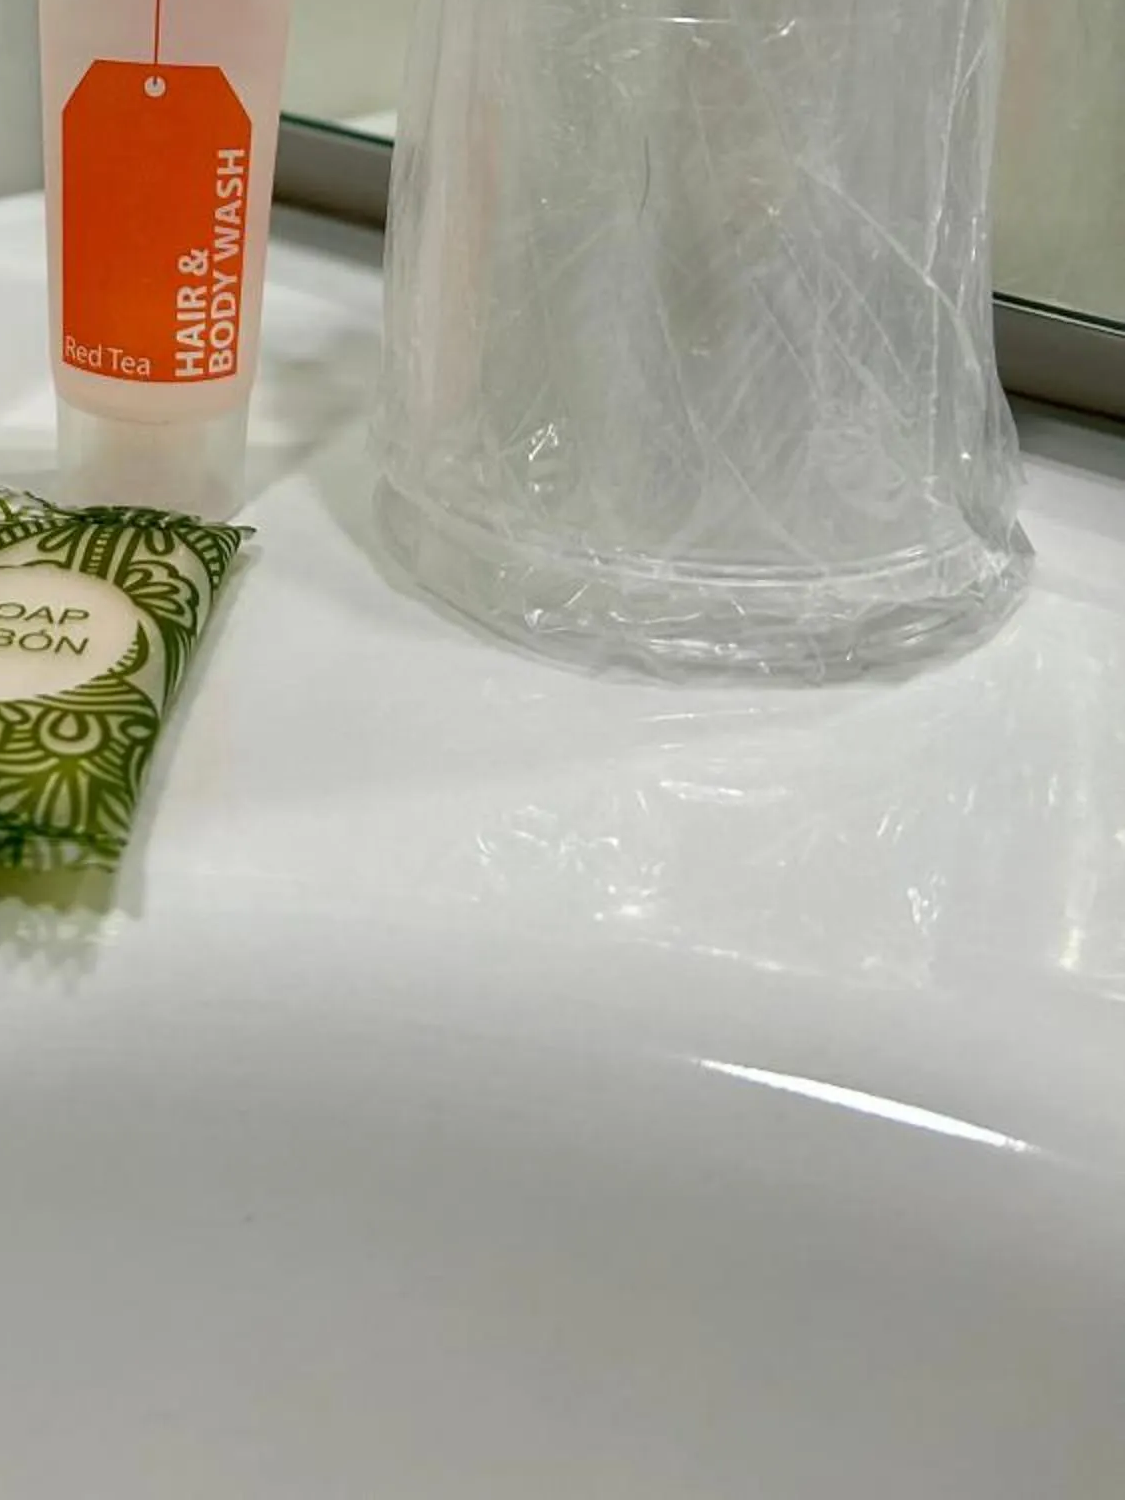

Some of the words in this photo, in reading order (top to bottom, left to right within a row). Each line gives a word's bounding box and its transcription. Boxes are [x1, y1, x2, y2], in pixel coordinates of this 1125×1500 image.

[214, 149, 245, 262] WASH
[178, 248, 209, 277] &
[64, 335, 102, 368] Red
[107, 347, 151, 376] Tea
[176, 286, 207, 377] HAIR
[209, 270, 238, 374] BODY
